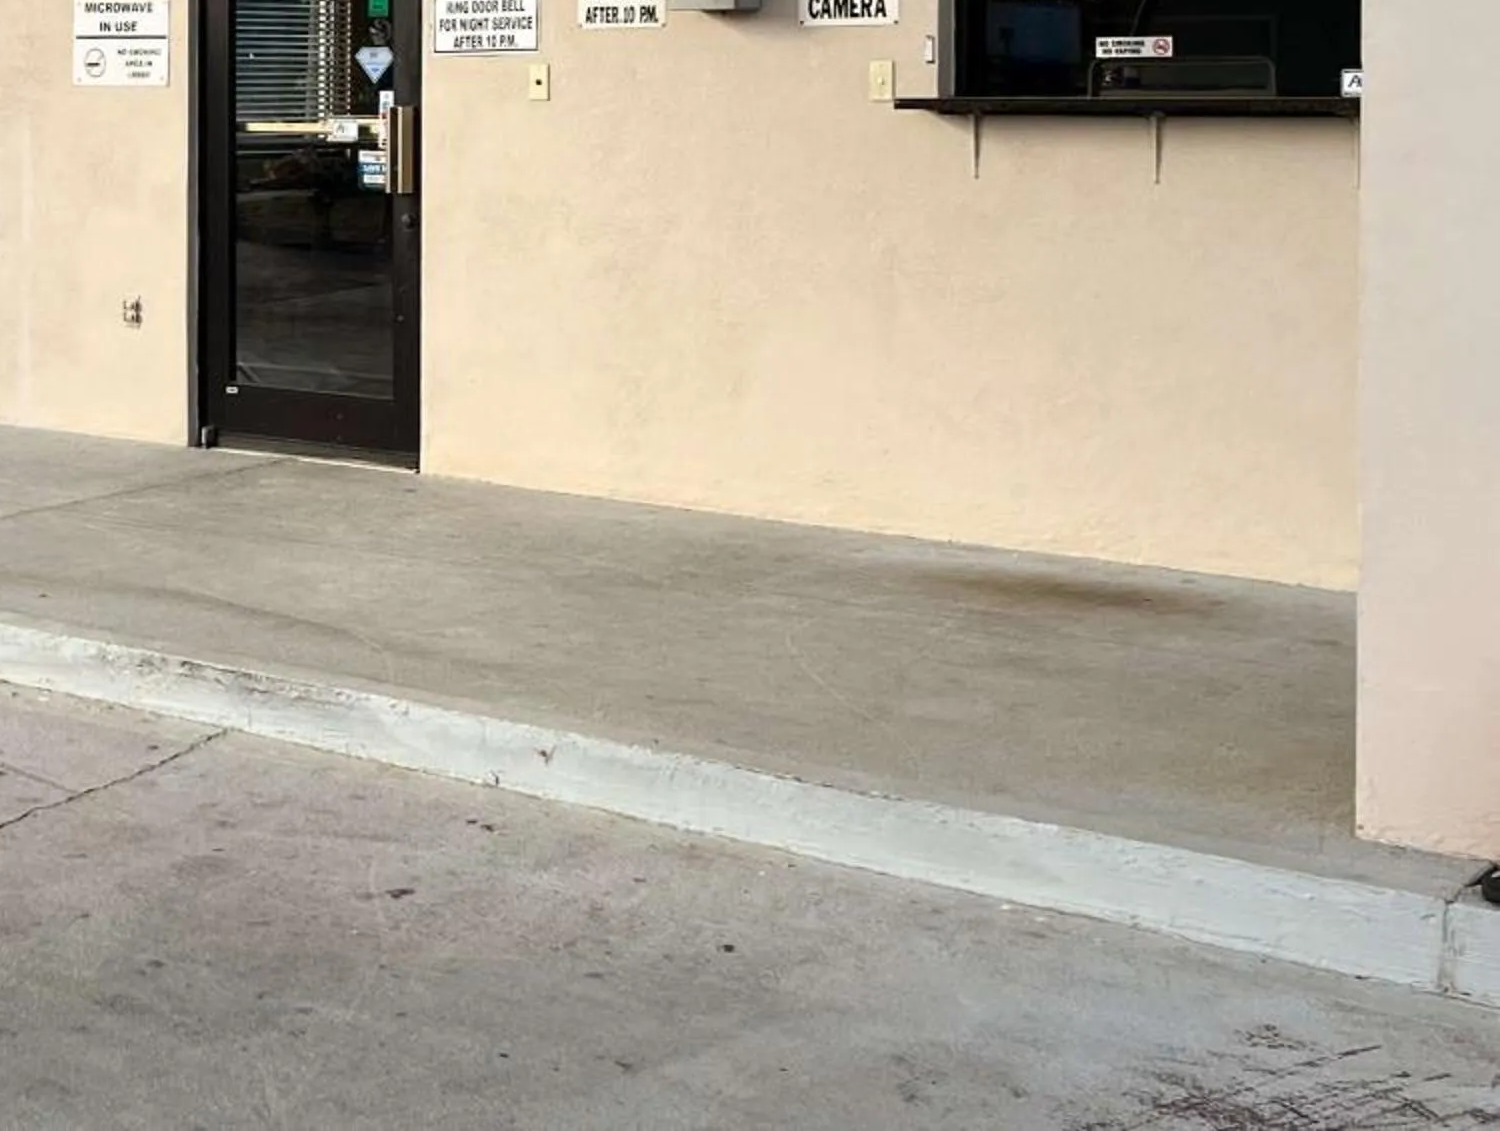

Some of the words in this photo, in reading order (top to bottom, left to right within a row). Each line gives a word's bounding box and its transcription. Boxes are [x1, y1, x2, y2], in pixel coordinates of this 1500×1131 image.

[84, 2, 153, 14] MICROWAVE
[446, 0, 469, 14] RING
[471, 0, 499, 13] DOOR
[585, 6, 618, 24] AFTER
[622, 6, 636, 23] 10
[100, 21, 111, 32] IN
[115, 21, 138, 32] USE
[440, 19, 457, 31] FOR
[459, 18, 489, 30] NIGHT
[492, 16, 533, 30] SERVICE
[453, 36, 482, 48] AFTER
